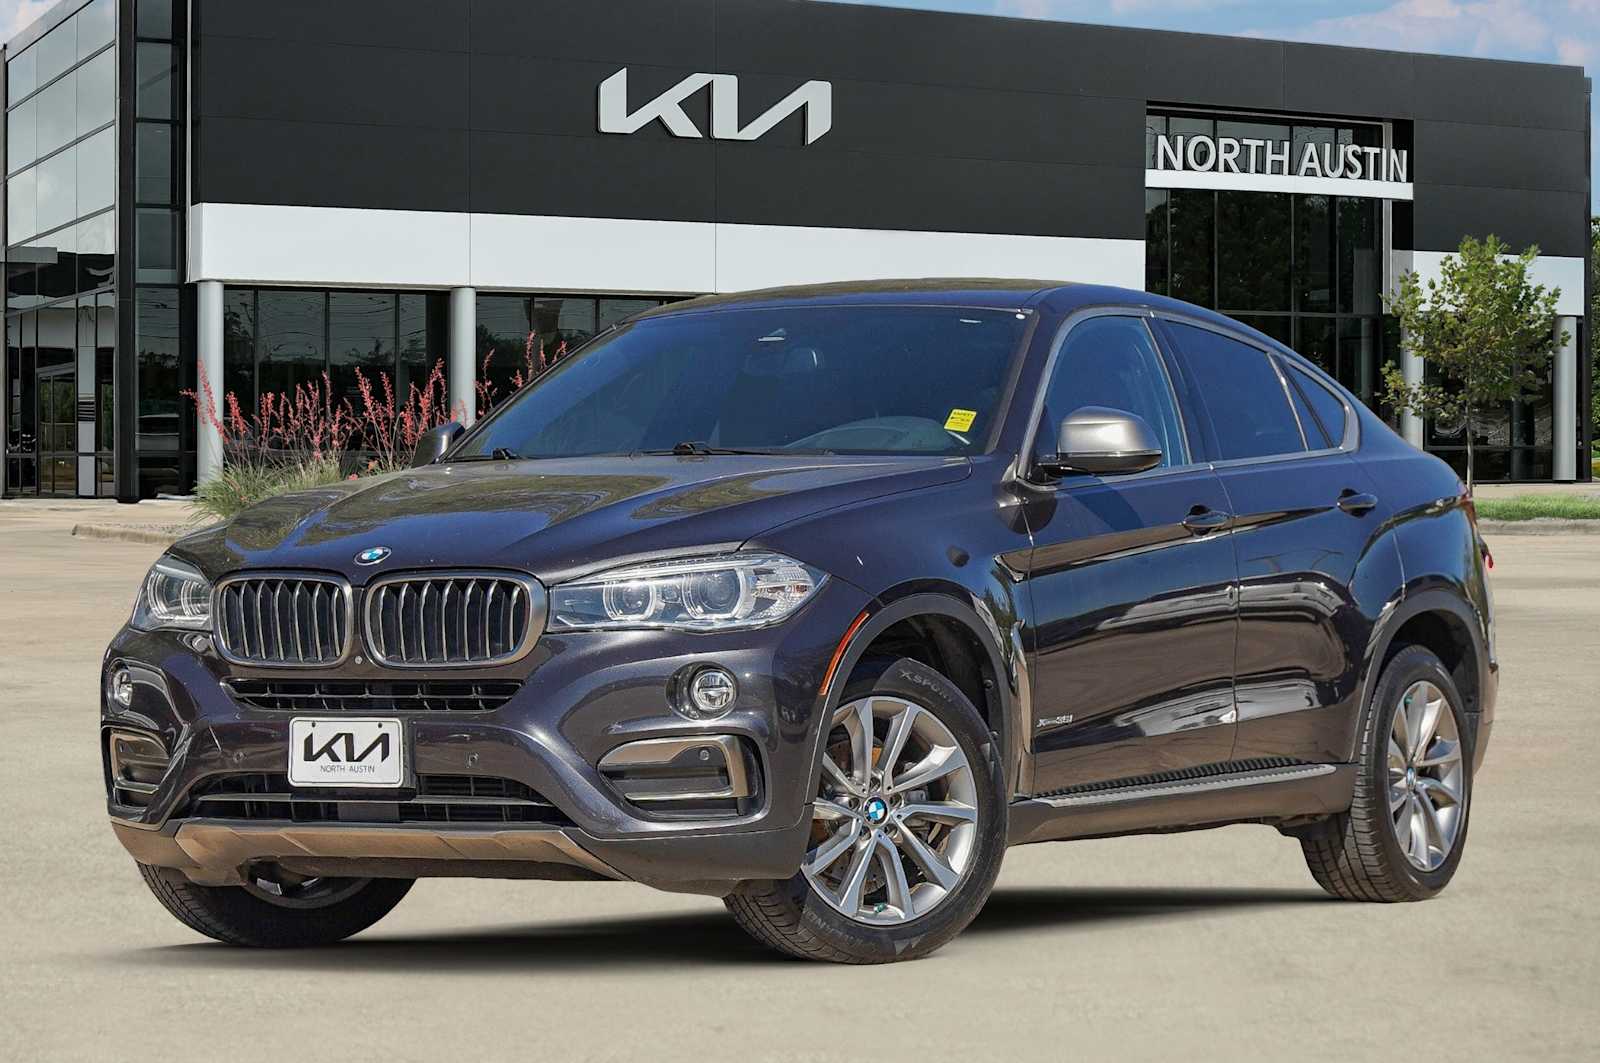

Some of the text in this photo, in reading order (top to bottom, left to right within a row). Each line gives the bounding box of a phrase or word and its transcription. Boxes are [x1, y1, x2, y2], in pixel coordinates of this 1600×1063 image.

[598, 67, 832, 145] KIA
[1157, 134, 1408, 183] NORTH AUSTIN
[303, 732, 390, 763] KIA
[320, 764, 375, 774] NORTH AUSTIN
